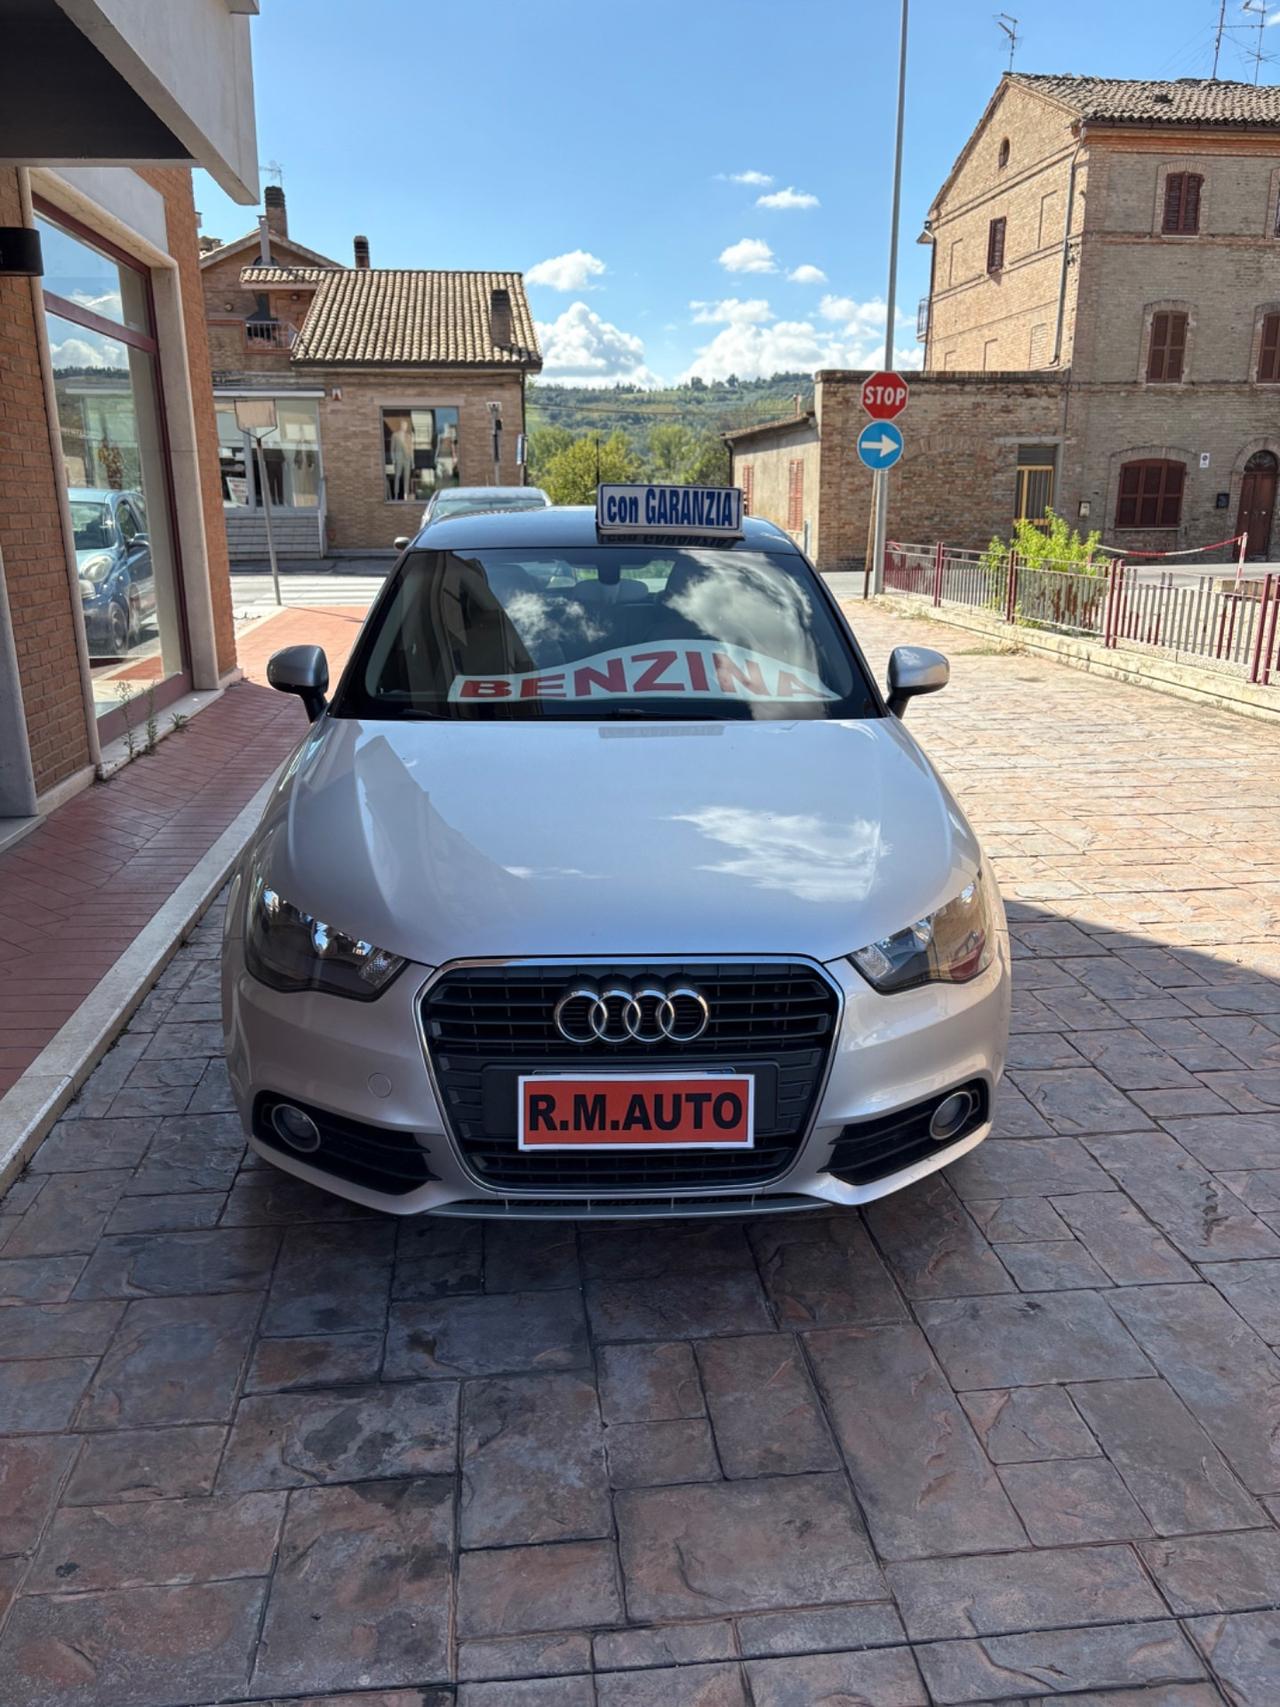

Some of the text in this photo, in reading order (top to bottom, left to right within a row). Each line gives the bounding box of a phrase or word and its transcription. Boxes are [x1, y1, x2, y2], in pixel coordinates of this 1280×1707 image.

[865, 386, 905, 406] STOP
[607, 488, 733, 526] con GARANZIA
[460, 651, 831, 698] BENZINA
[529, 1092, 742, 1131] R.M.AUTO
